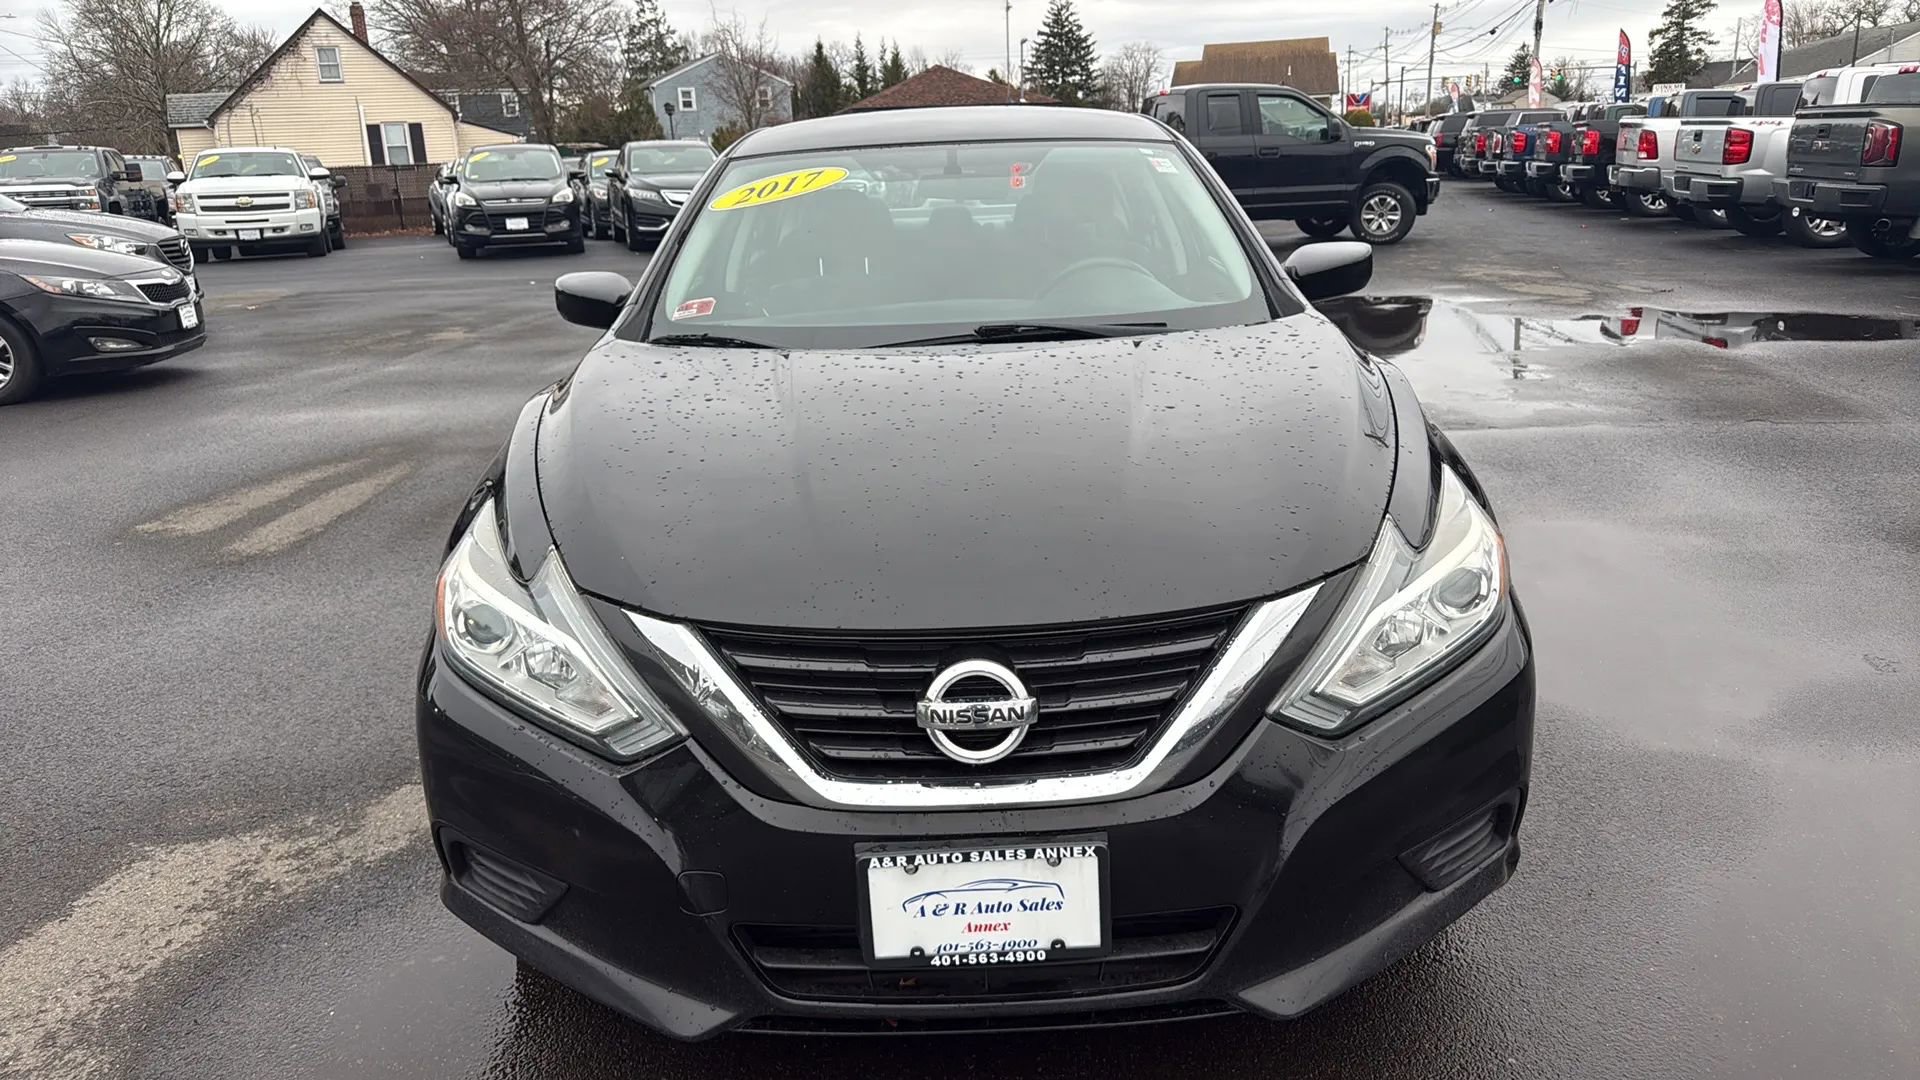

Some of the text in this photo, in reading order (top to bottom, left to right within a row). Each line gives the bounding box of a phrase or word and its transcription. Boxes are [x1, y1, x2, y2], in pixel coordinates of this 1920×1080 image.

[731, 170, 826, 206] 2017
[929, 705, 1025, 724] NISSAN
[868, 845, 1097, 869] A&R AUTO SALES ANNEX
[913, 897, 1064, 918] A & R Auto Sales
[961, 921, 1011, 934] Annex
[933, 938, 1038, 953] 401-563-4900
[930, 950, 1046, 967] 401-563-4900
